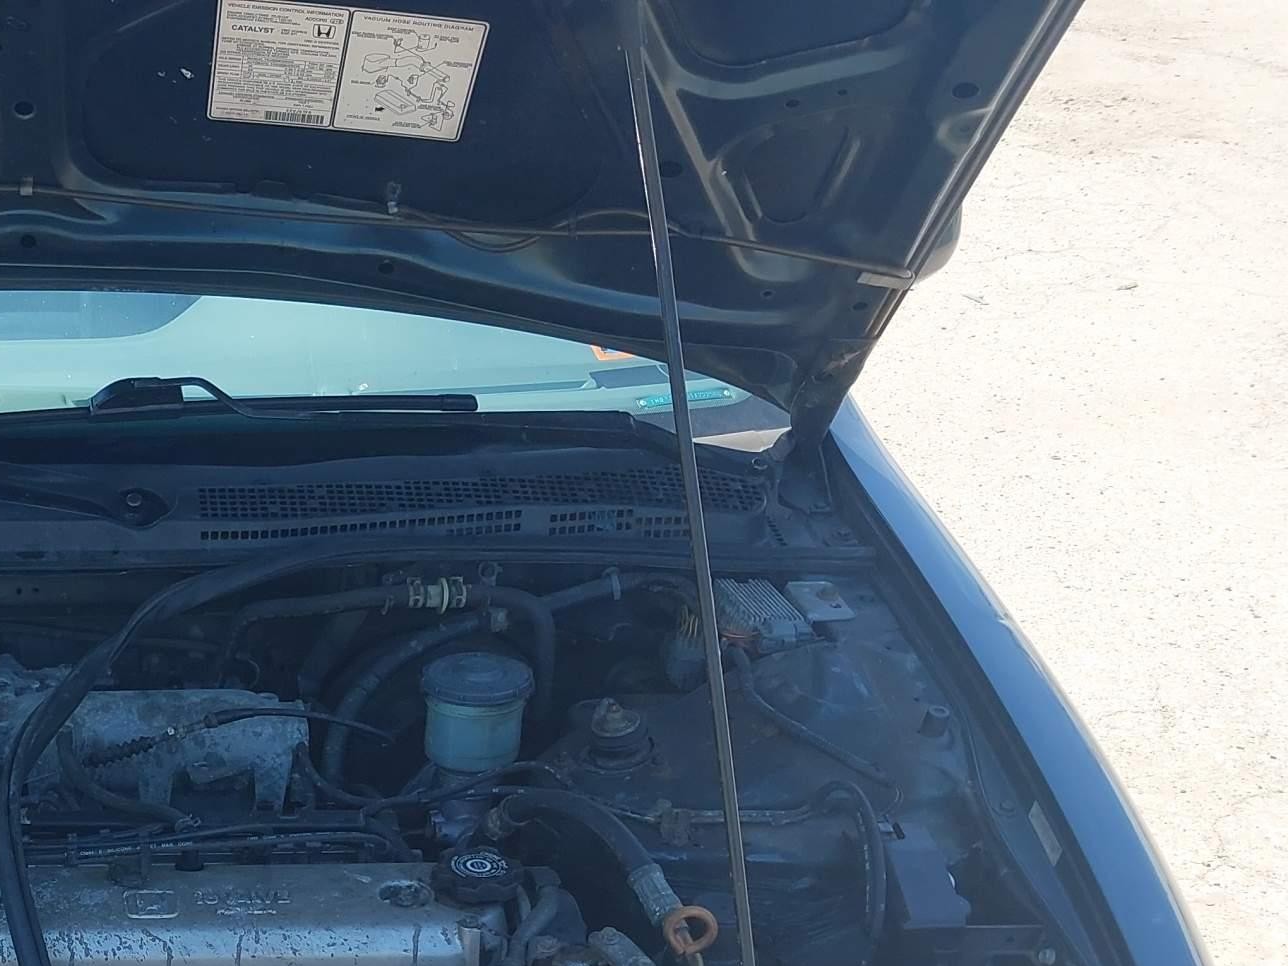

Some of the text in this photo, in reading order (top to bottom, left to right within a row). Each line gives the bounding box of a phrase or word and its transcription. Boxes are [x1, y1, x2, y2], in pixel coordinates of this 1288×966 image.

[306, 10, 345, 18] INFORMATION
[363, 15, 391, 23] VACUUM
[412, 20, 442, 29] ROUTING
[443, 24, 475, 32] DIAGRAM
[231, 24, 276, 34] CATALYST
